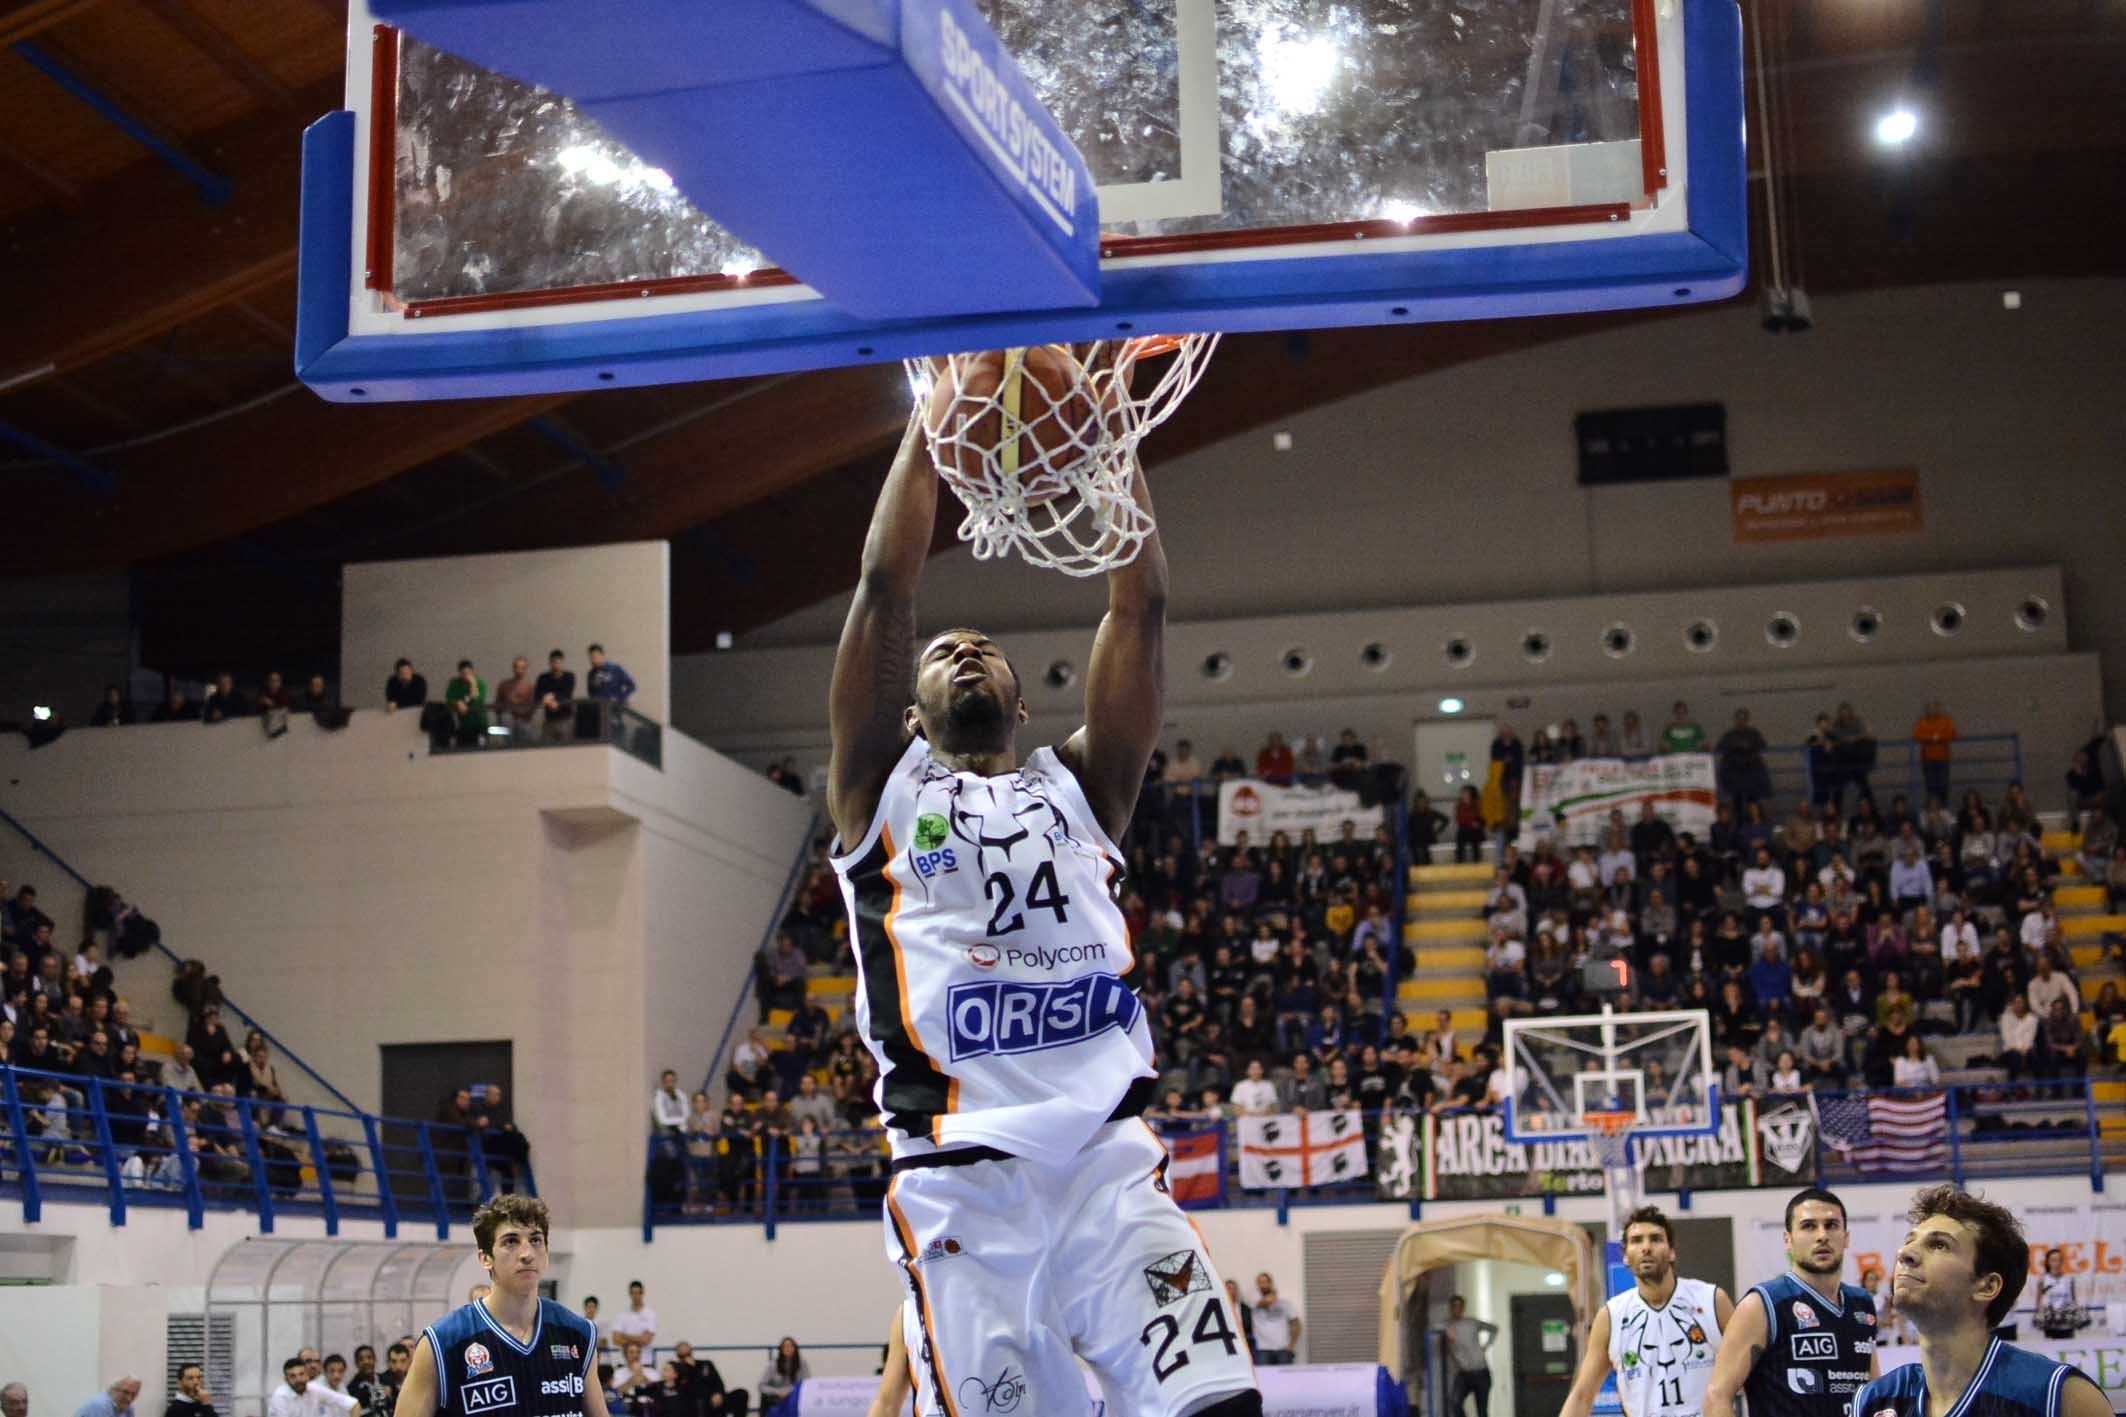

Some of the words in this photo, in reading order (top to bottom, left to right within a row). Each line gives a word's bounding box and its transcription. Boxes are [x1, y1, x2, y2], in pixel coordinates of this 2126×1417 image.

[940, 8, 1010, 142] SPORT
[1008, 100, 1076, 218] SYSTEM
[916, 849, 957, 876] BPS
[984, 860, 1070, 938] 24
[1006, 943, 1106, 971] Polycom
[954, 983, 1123, 1043] ORSI
[1140, 1297, 1238, 1385] 24
[1798, 1338, 1833, 1356] AIG
[469, 1383, 509, 1408] AIG
[1658, 1377, 1685, 1407] 11
